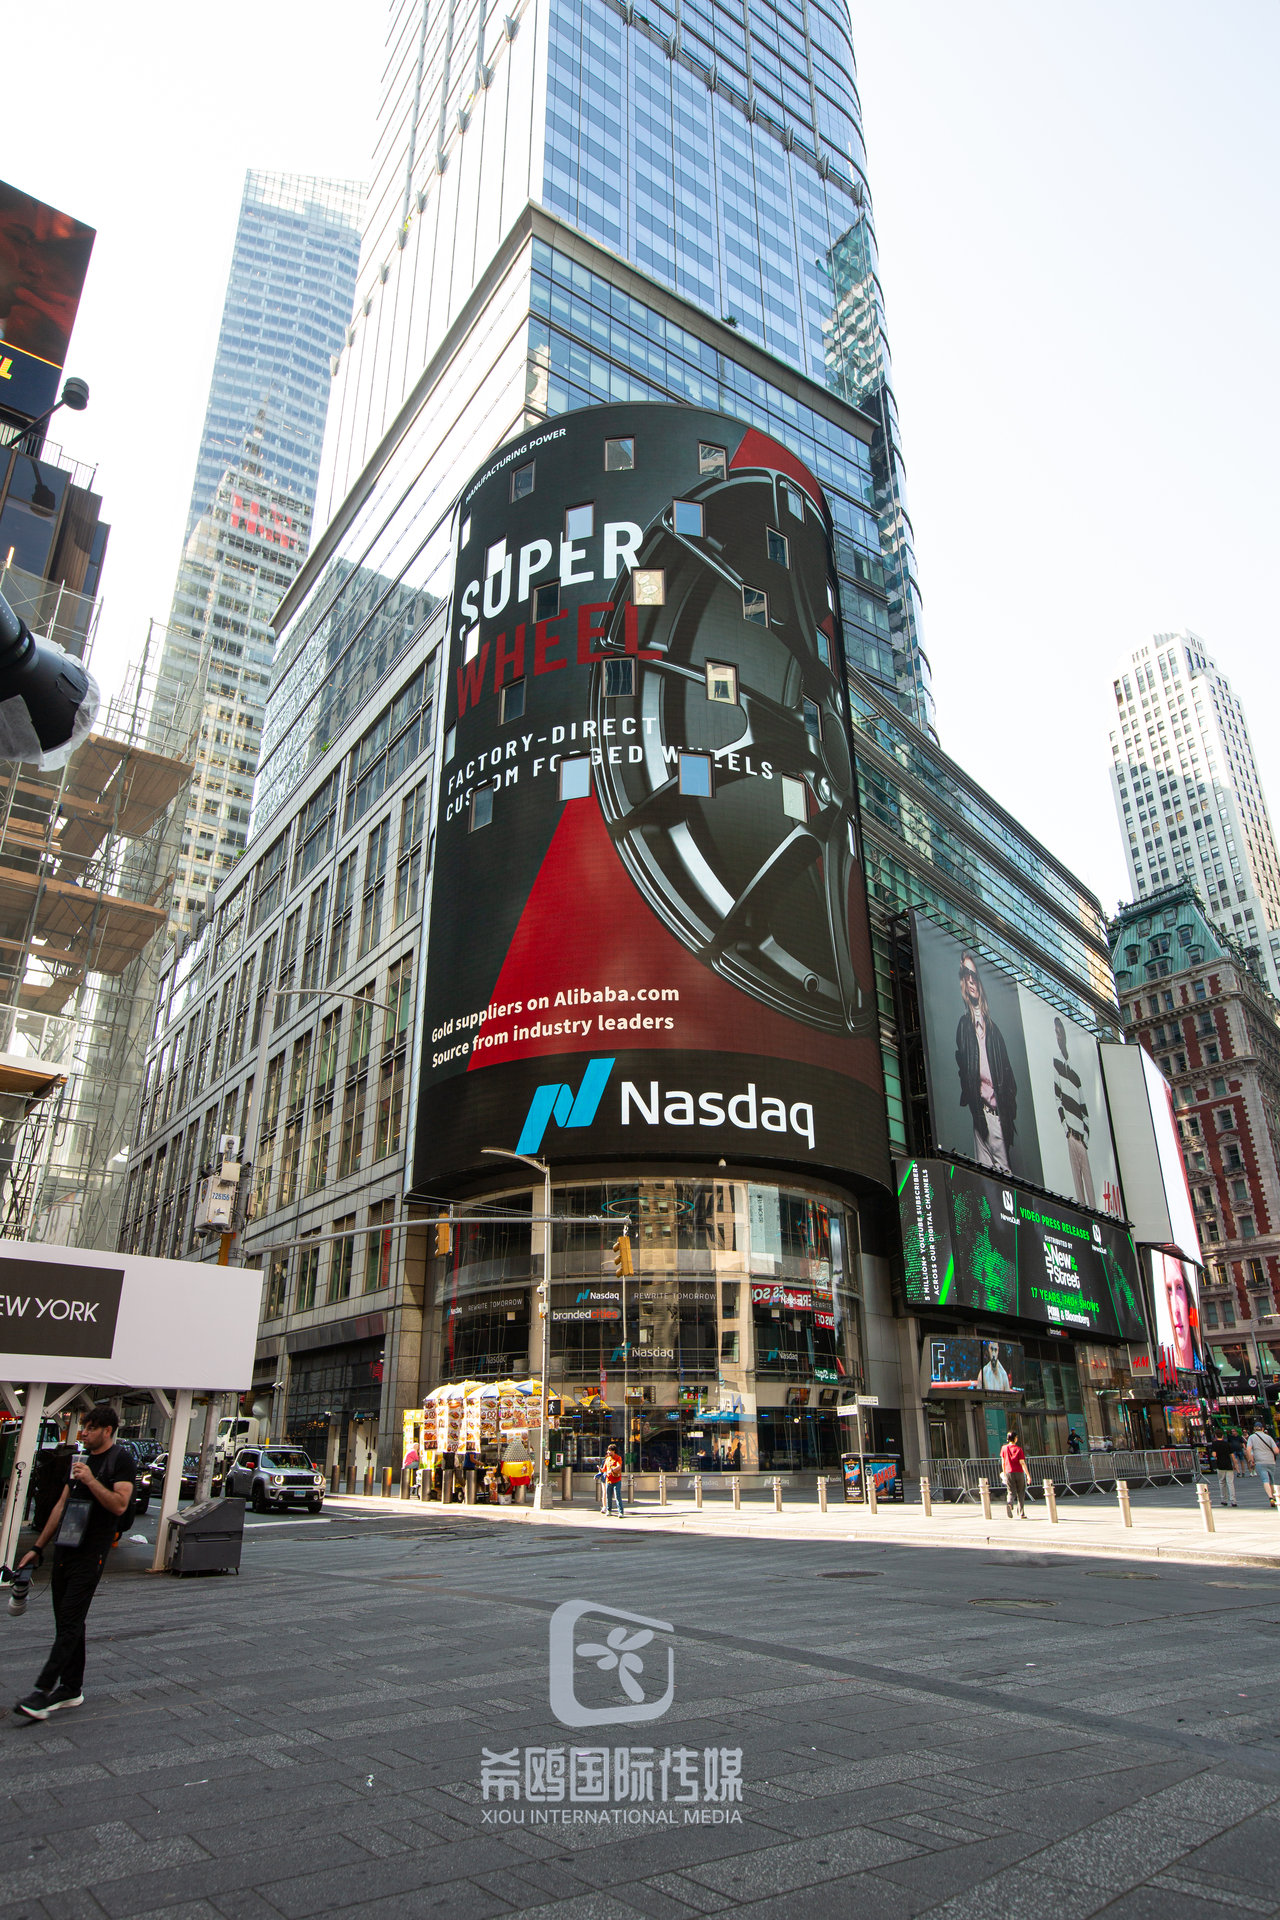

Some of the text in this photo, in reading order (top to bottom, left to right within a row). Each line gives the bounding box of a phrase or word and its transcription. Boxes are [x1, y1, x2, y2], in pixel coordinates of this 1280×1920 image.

[465, 428, 567, 504] MANUFACTURING POWER
[459, 521, 644, 641] SUPER
[456, 601, 663, 719] WHEEL
[447, 716, 657, 796] FACTORY-DIRECT
[533, 745, 644, 777] FOGED
[431, 986, 680, 1043] Gold suppliers on Alibaba.com
[432, 1013, 675, 1068] Source from industry leaders
[620, 1080, 816, 1150] Nasdaq
[912, 1163, 923, 1215] SUBSCRIBERS
[922, 1169, 932, 1210] CHANNELS
[916, 1217, 925, 1254] YOUTUBE
[926, 1211, 934, 1242] DIGITAL
[1020, 1207, 1090, 1241] VIDEO PRESS RELEASES
[1051, 1244, 1072, 1270] New
[921, 1255, 930, 1294] MILLION+
[932, 1263, 940, 1296] ACROSS
[1053, 1265, 1081, 1289] Street
[35, 1297, 100, 1323] YORK
[468, 1301, 488, 1312] REWRITE
[490, 1298, 523, 1308] TOMORROW
[590, 1291, 717, 1301] Nasdaq REWRITE TOMORROW
[1031, 1287, 1037, 1298] 17
[1079, 1298, 1100, 1313] SHOWS
[485, 1353, 508, 1365] Nasdaq
[632, 1346, 674, 1359] Nasdaq
